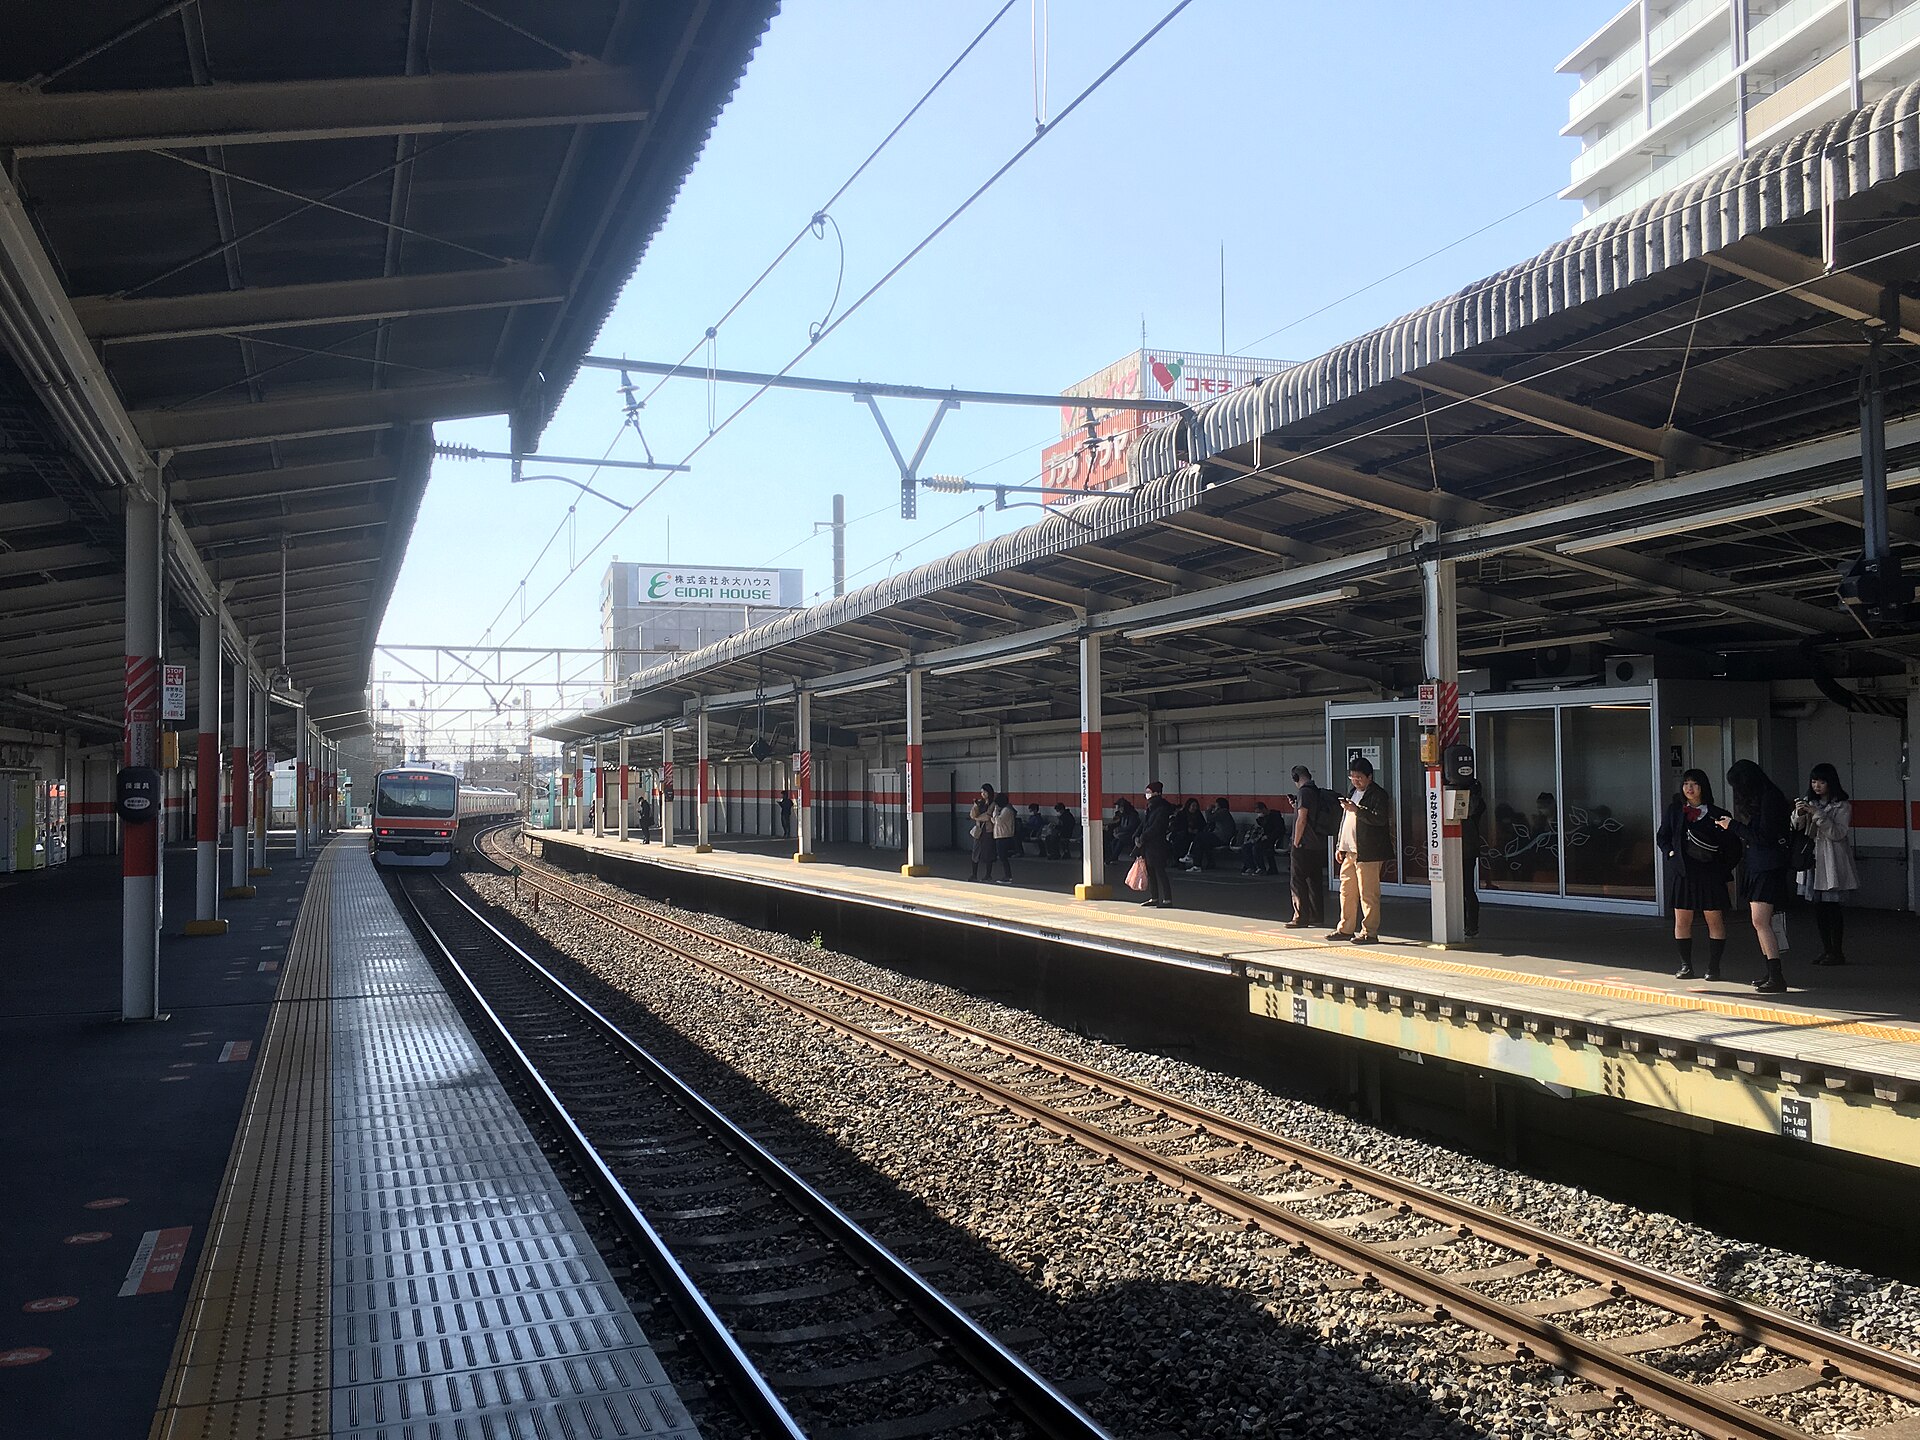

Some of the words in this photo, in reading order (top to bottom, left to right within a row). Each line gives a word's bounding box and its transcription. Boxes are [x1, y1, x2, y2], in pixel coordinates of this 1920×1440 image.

[674, 575, 771, 587] 株式会社永大ハウス
[674, 587, 713, 598] EIDAI
[719, 588, 771, 600] HOUSE
[1429, 791, 1439, 849] みなみうらわ
